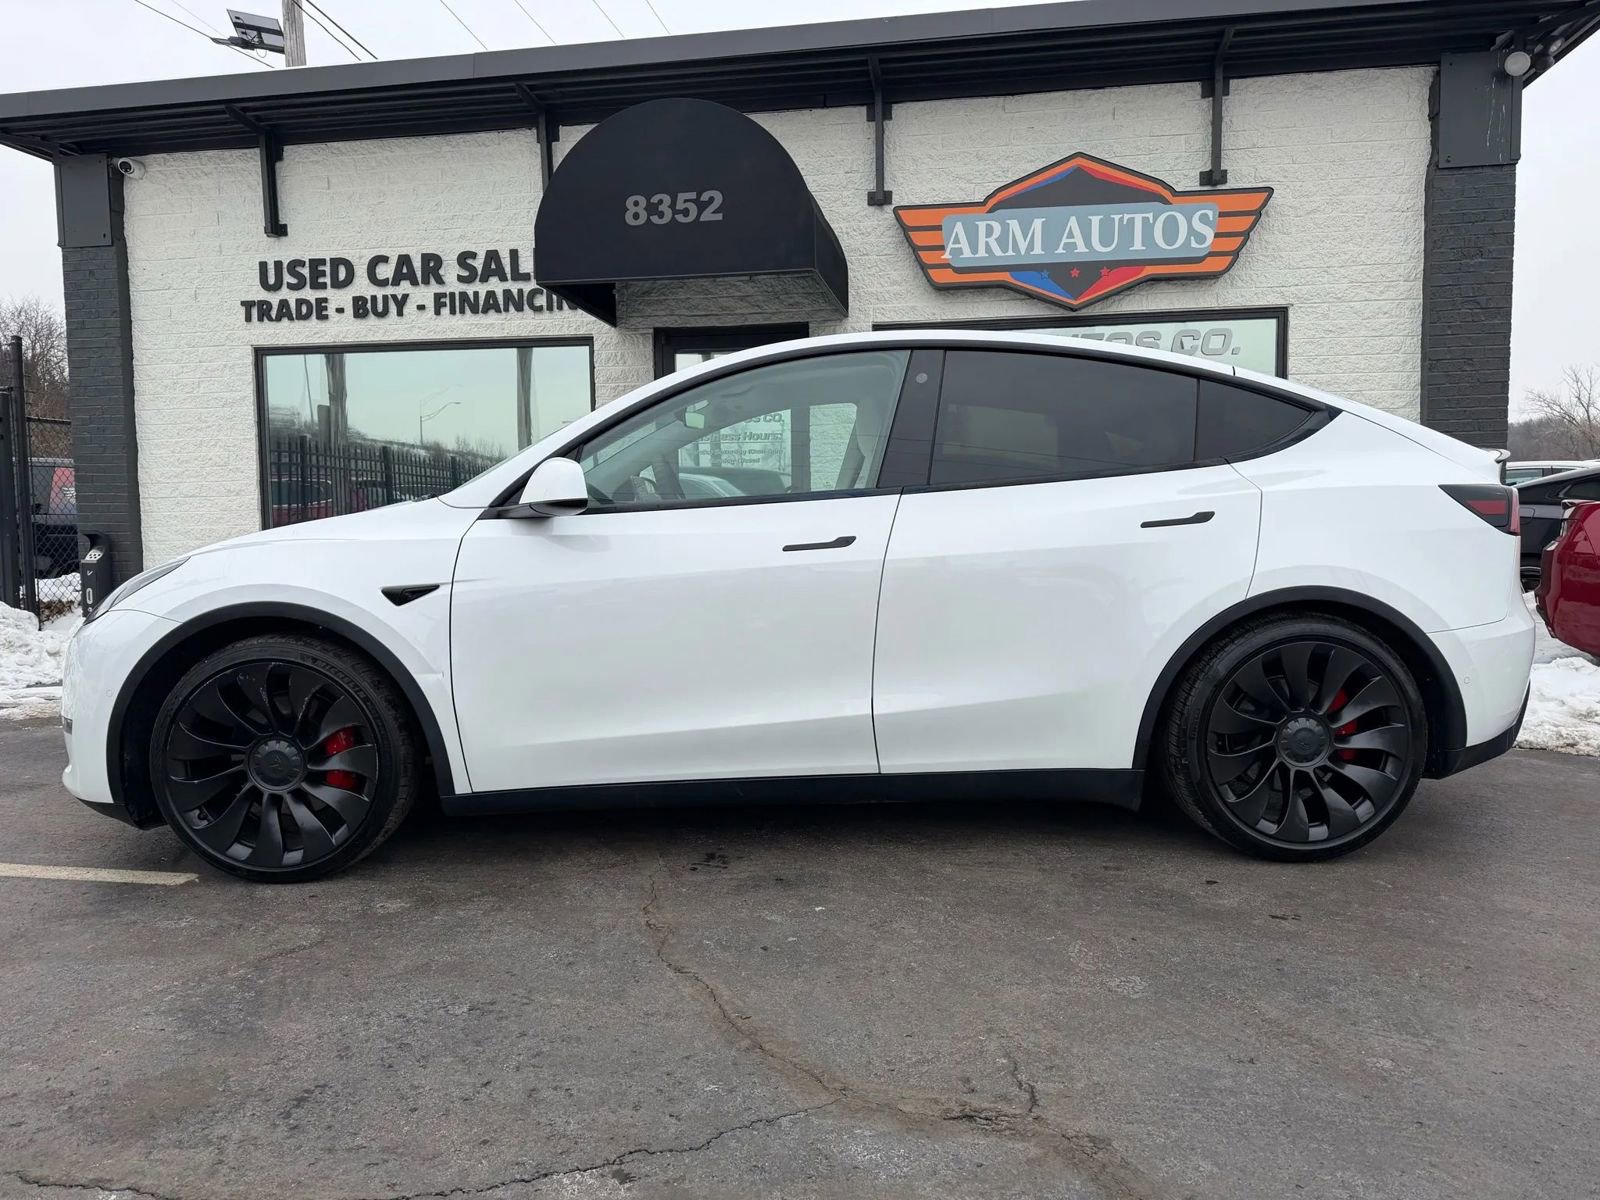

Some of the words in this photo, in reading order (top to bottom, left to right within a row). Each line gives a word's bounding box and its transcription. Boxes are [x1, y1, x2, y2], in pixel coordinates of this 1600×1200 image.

[624, 190, 724, 226] 8352
[941, 217, 1046, 259] ARM
[1054, 209, 1216, 254] AUTOS
[258, 257, 355, 292] USED
[366, 253, 446, 287] CAR
[456, 248, 537, 283] SAL
[240, 297, 329, 323] TRADE
[352, 293, 410, 319] BUY
[433, 288, 578, 316] FINANCI
